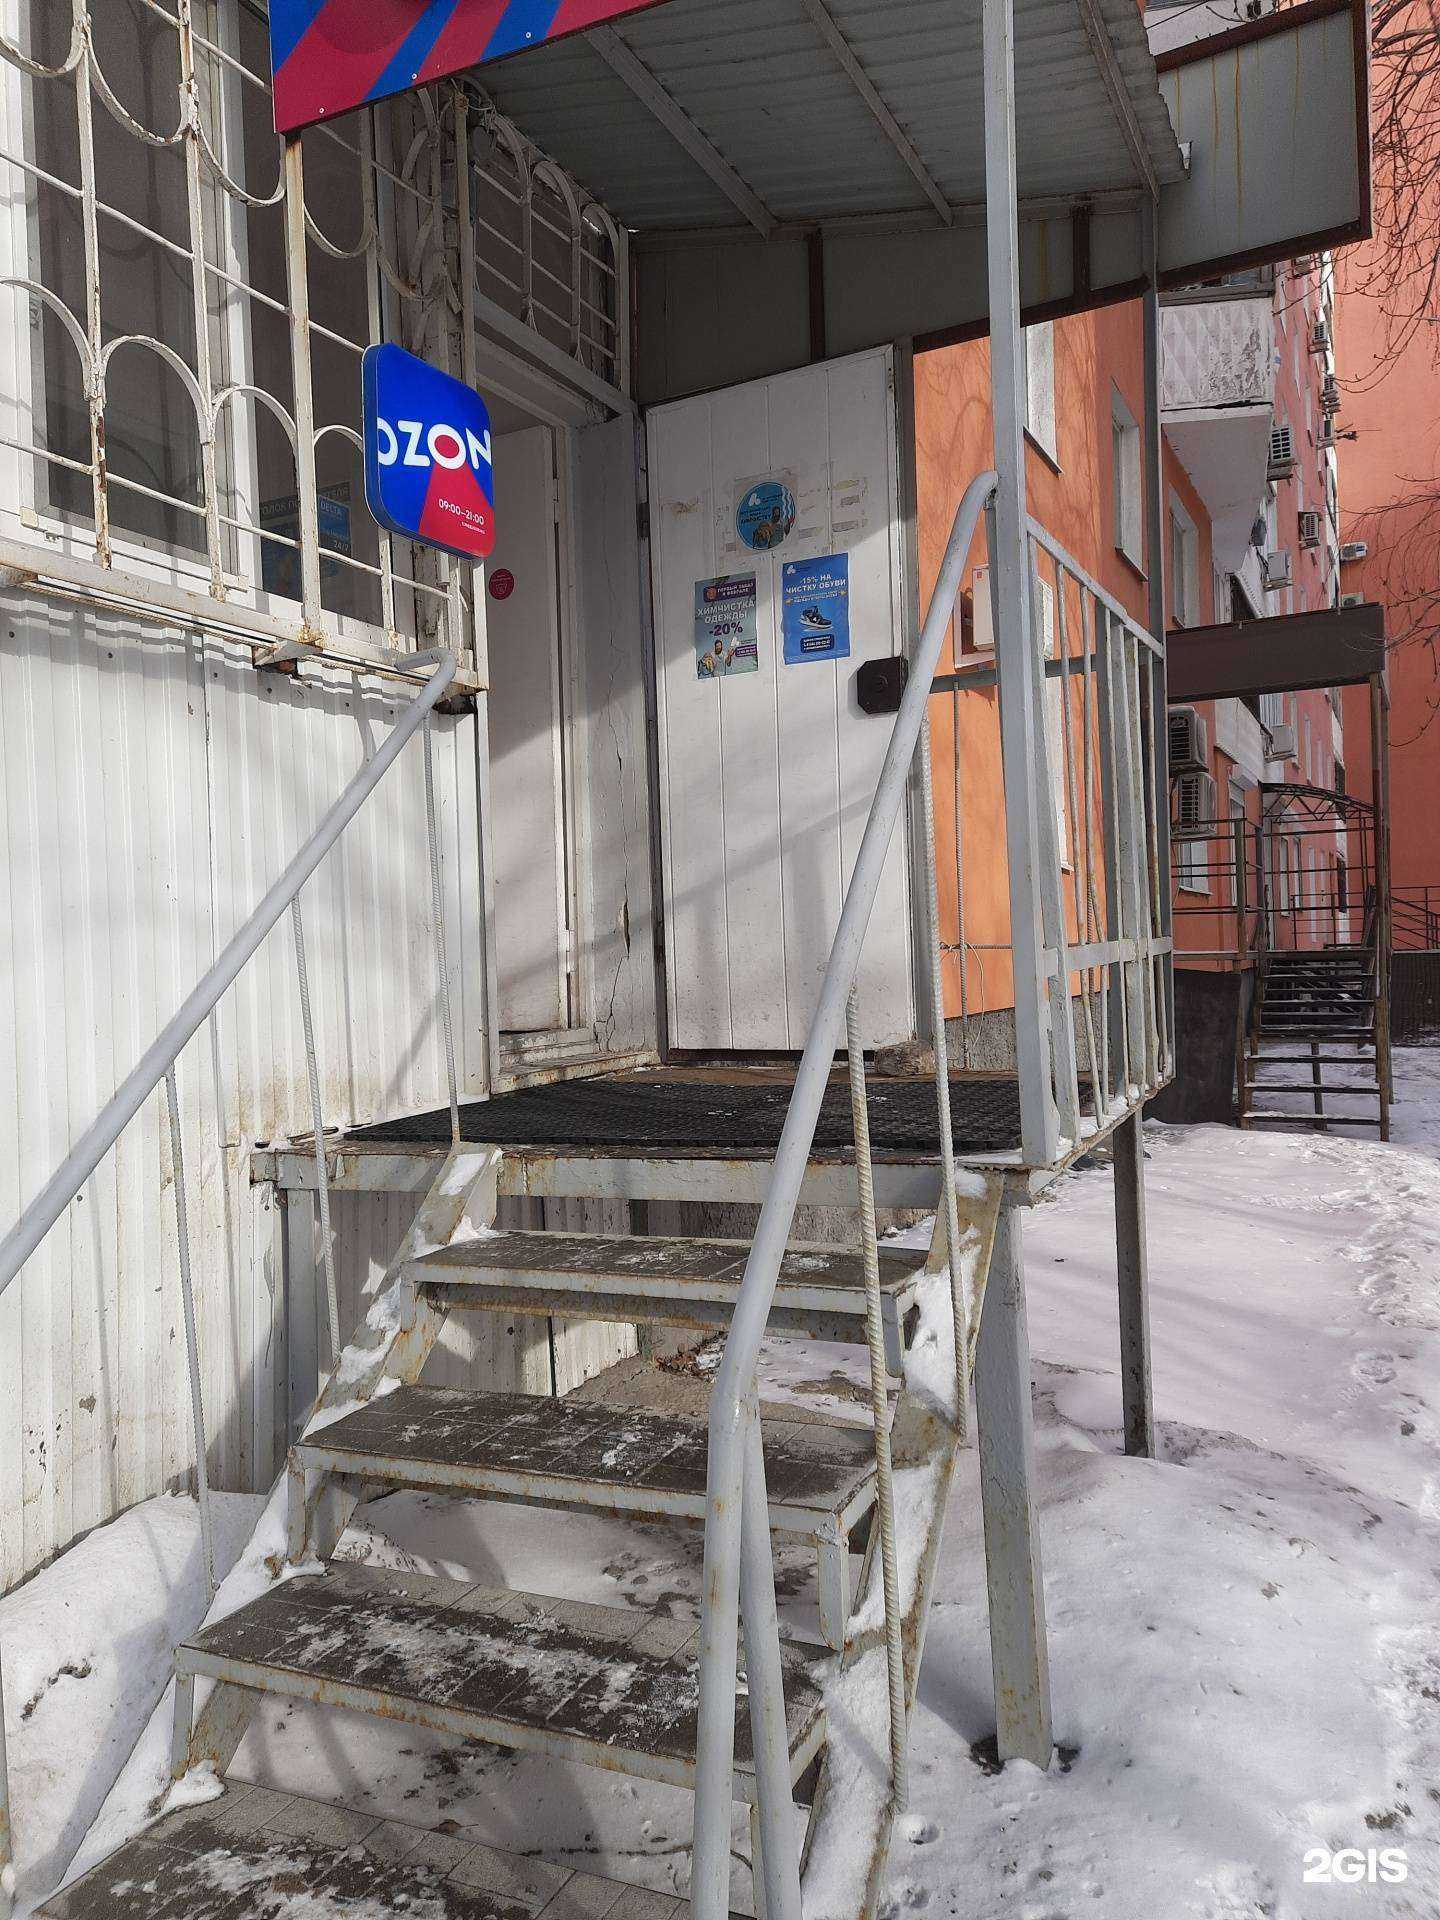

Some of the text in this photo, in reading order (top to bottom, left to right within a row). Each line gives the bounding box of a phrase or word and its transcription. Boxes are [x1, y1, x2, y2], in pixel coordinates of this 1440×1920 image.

[786, 579, 846, 594] ЧИСТКУ ОБУВИ
[697, 600, 755, 616] ХИМЧИСТКА
[705, 611, 748, 624] ОДЕЖДЫ
[709, 621, 743, 637] -20%
